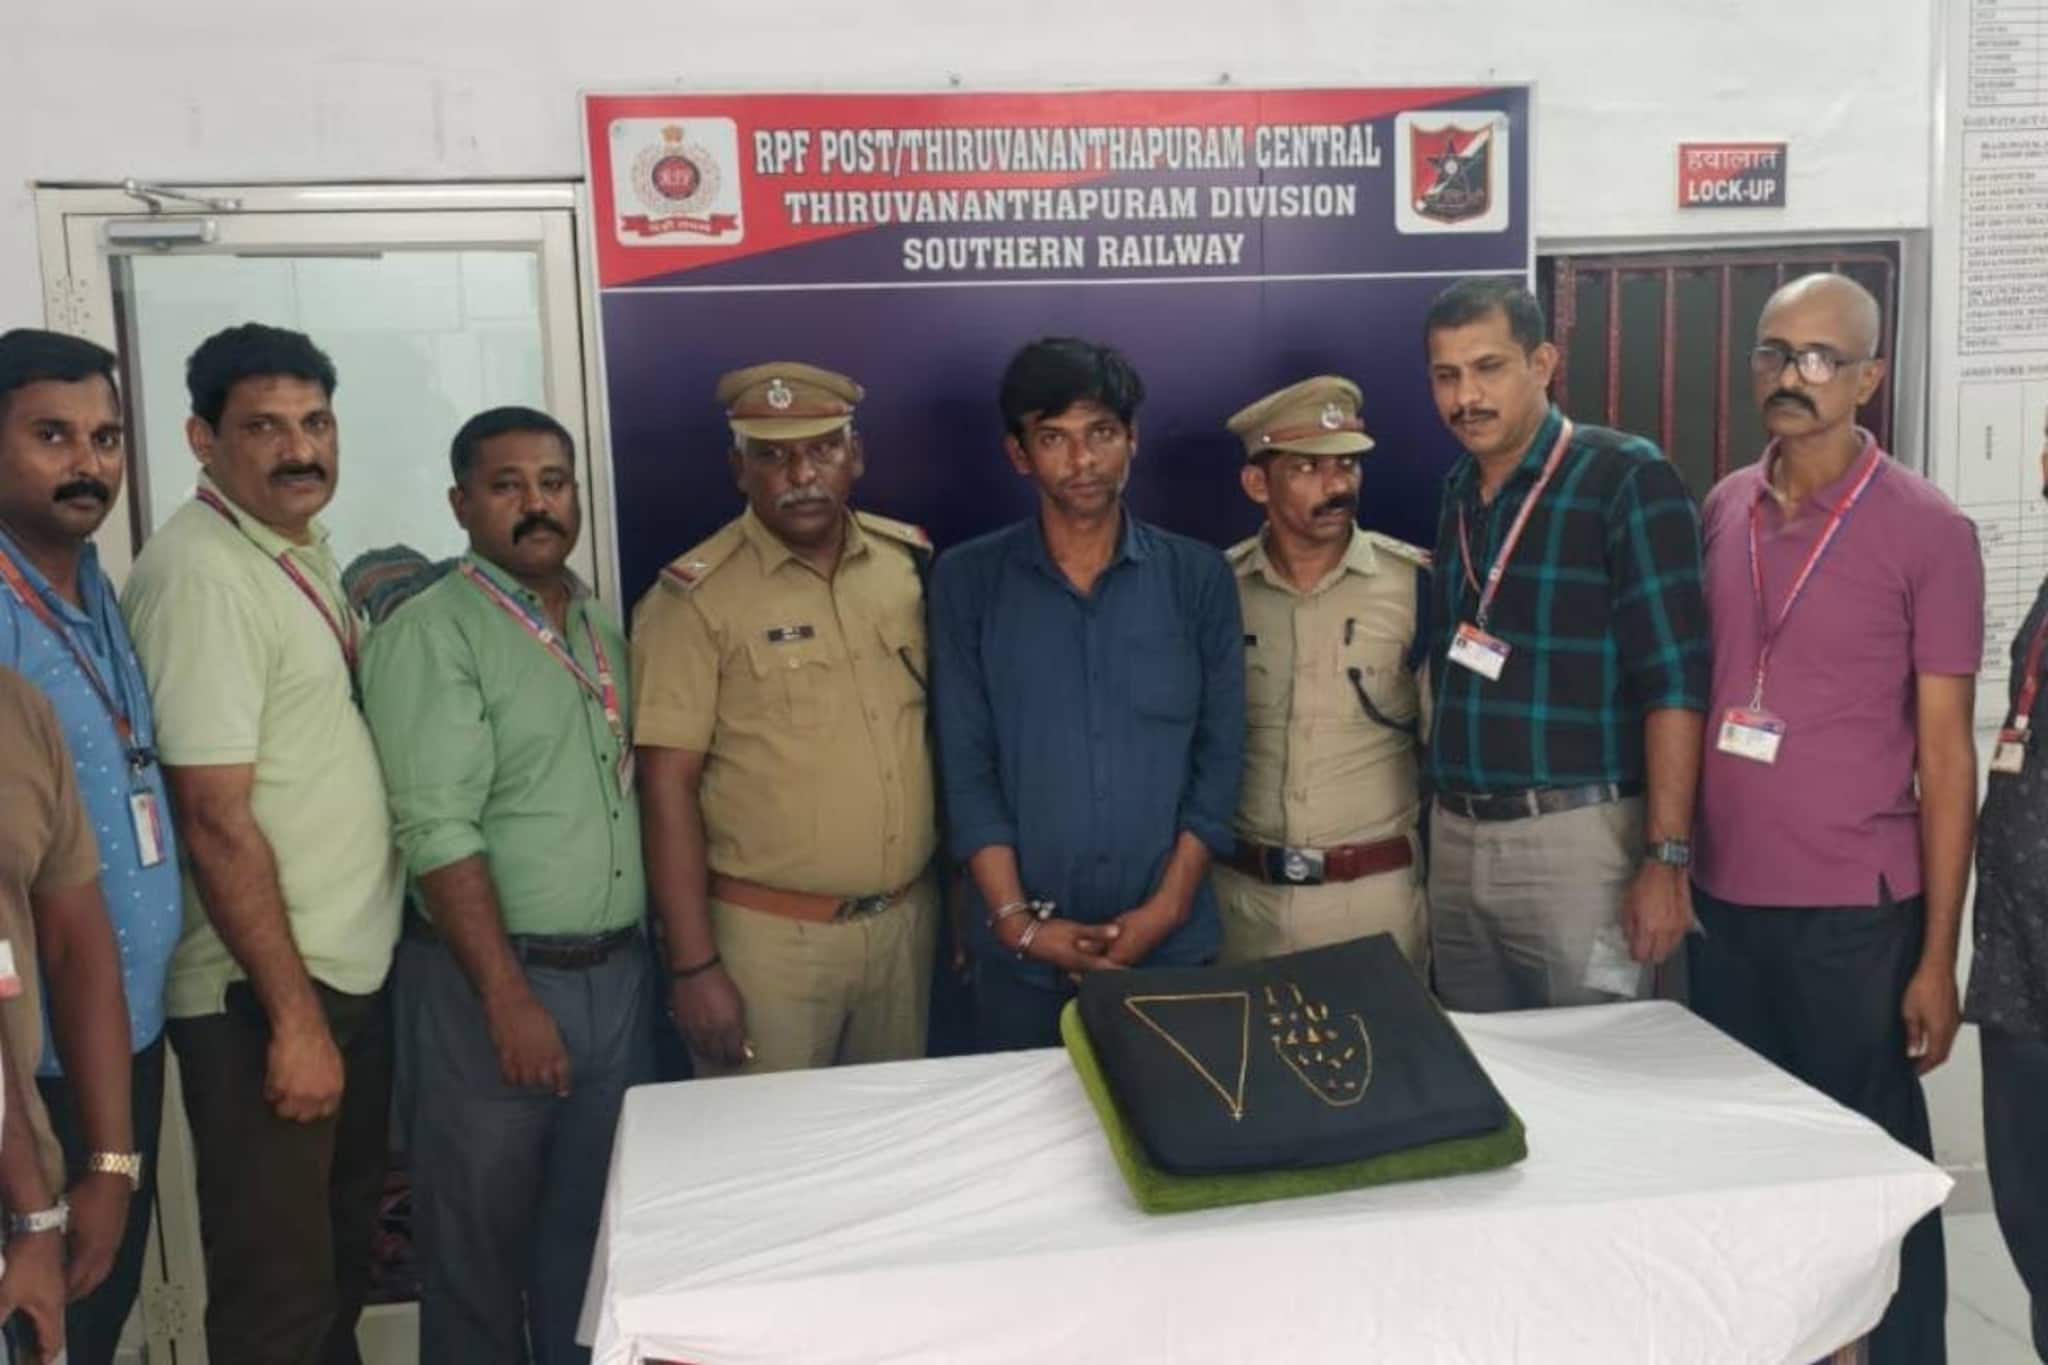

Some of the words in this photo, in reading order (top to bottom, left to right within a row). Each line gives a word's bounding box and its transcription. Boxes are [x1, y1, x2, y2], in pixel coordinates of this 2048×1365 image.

[754, 130, 809, 175] RPF
[821, 124, 1245, 176] POST/THIRUVANANTHAPURAM
[1255, 123, 1382, 168] CENTRAL
[785, 189, 1197, 224] THIRUVANANTHAPURAM
[1210, 185, 1357, 219] DIVISION
[1688, 179, 1776, 201] LOCK-UP
[903, 237, 1085, 271] SOUTHERN
[1098, 234, 1245, 269] RAILWAY
